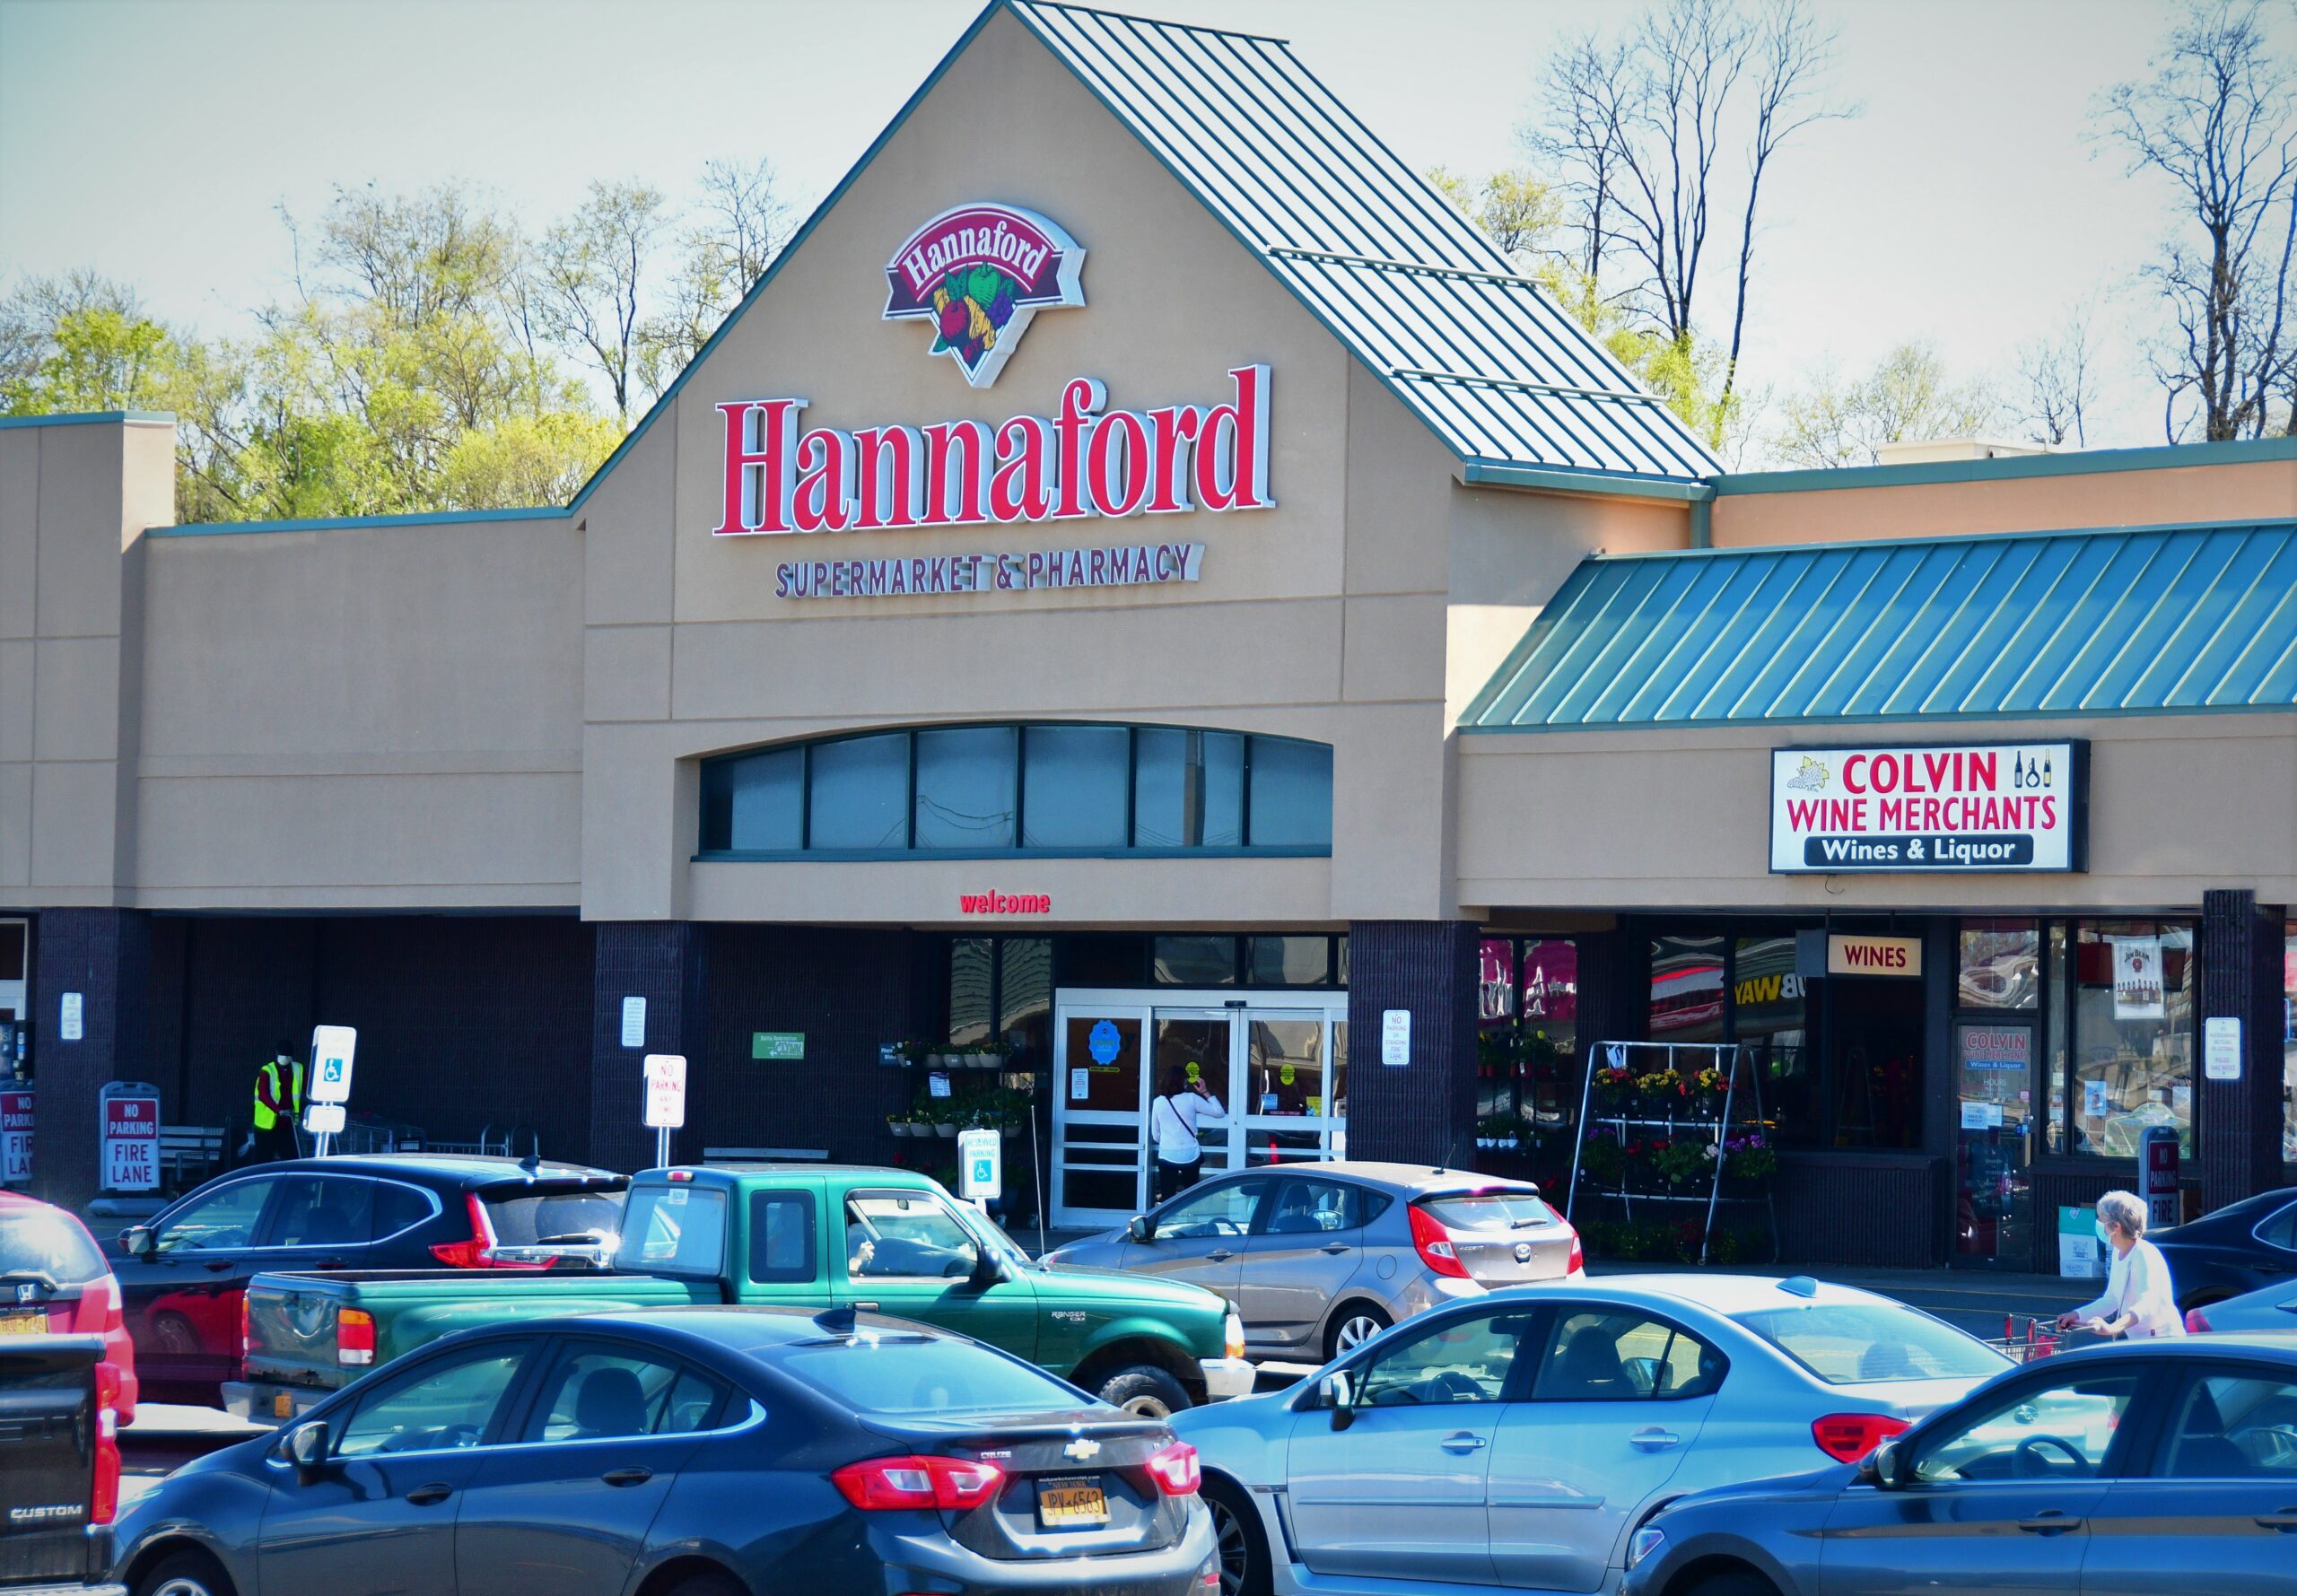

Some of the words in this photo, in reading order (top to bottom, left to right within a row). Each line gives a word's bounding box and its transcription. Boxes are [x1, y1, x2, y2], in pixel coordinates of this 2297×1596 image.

[902, 221, 1048, 289] Hannaford
[712, 363, 1271, 536] Hannaford
[775, 554, 983, 598] SUPERMARKET
[996, 553, 1015, 589] &
[1026, 544, 1192, 588] PHARMACY
[1842, 752, 1997, 794] COLVIN
[1786, 798, 1867, 833] WINE
[1879, 795, 2057, 832] MERCHANTS
[1821, 839, 1899, 860] Wines
[1907, 839, 1925, 859] &
[1935, 837, 2016, 865] Liquor
[960, 889, 1051, 913] welcome
[1844, 945, 1907, 968] WINES
[1392, 1016, 1402, 1024] NO
[1967, 1033, 2027, 1050] COLVIN
[659, 1065, 674, 1077] NO
[651, 1079, 682, 1092] PARKING
[18, 1096, 32, 1110] NO
[124, 1103, 139, 1118] NO
[109, 1121, 154, 1135] PARKING
[11, 1136, 33, 1154] FIR
[115, 1144, 149, 1161] FIRE
[2159, 1147, 2169, 1164] NO
[112, 1165, 153, 1182] LANE
[2150, 1170, 2177, 1188] PARKING
[2153, 1199, 2173, 1223] FIRE
[10, 1504, 83, 1519] CUSTOM
